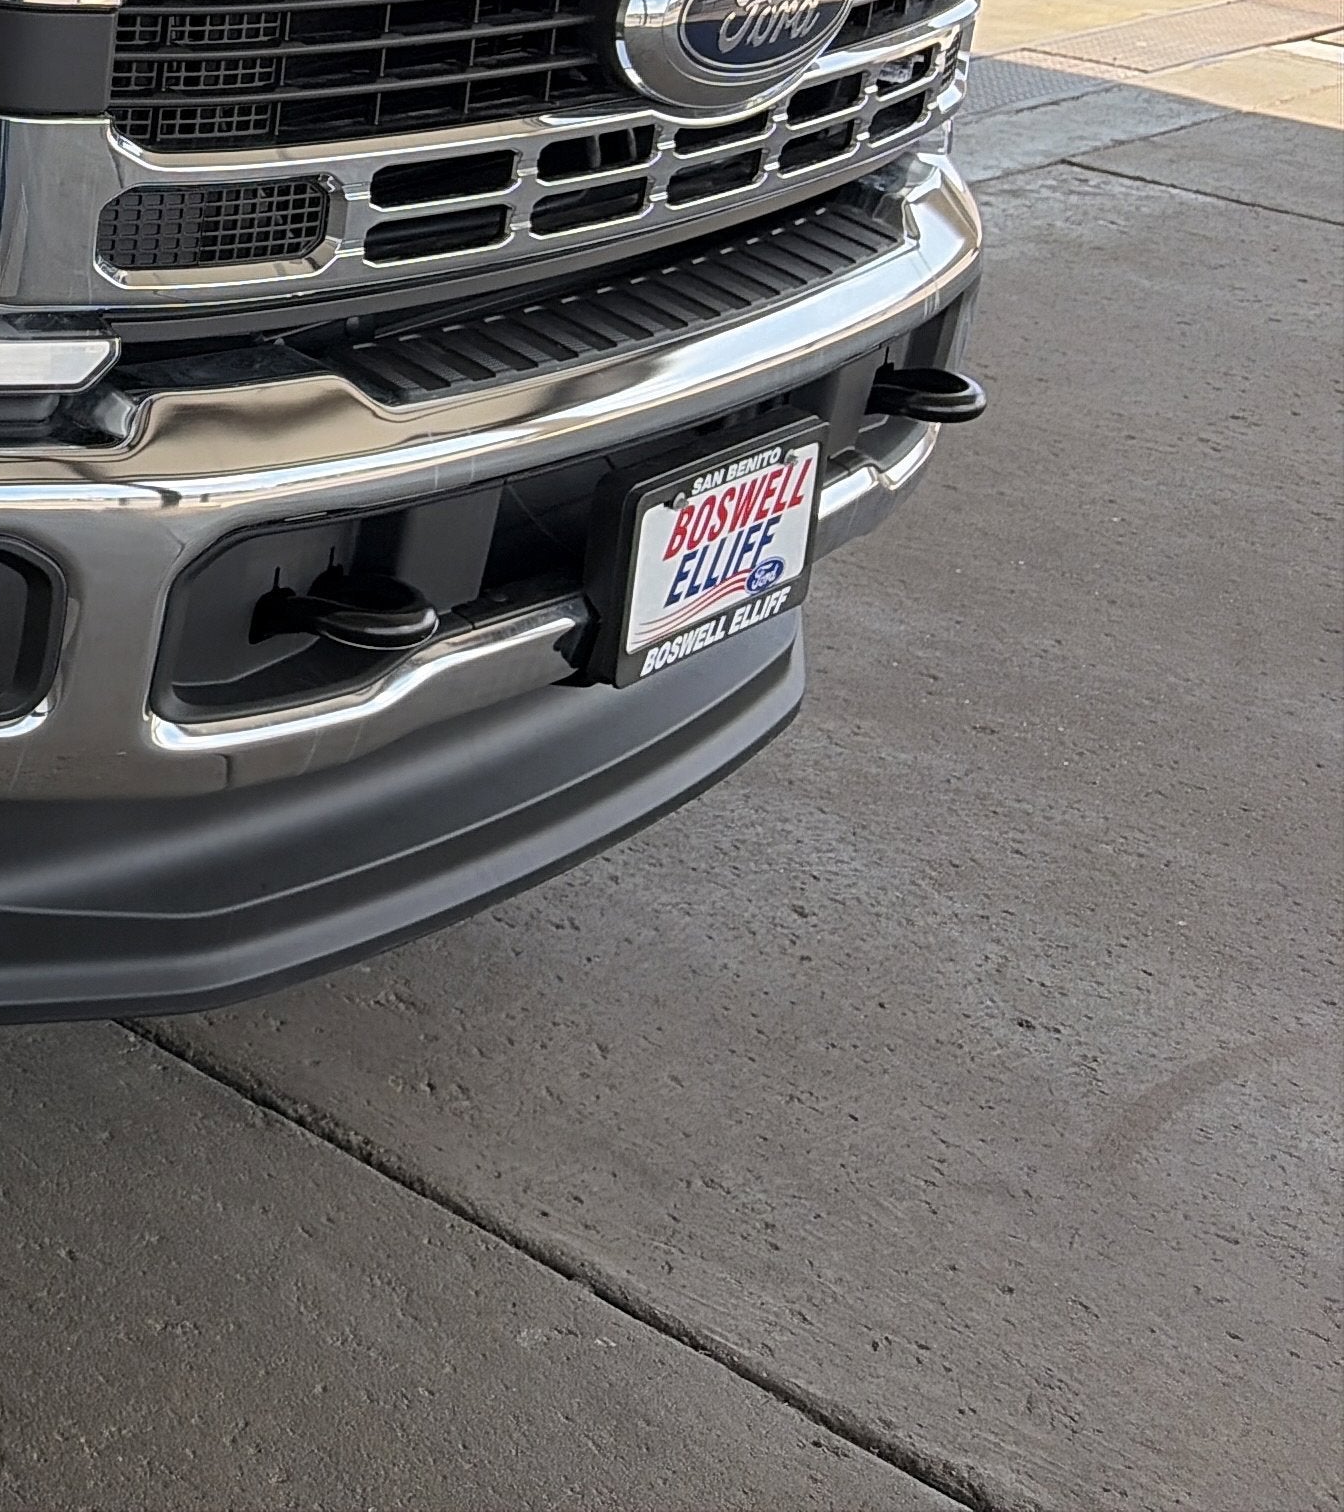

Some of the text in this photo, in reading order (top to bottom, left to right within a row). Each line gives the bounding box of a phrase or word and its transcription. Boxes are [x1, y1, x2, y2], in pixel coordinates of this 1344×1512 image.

[663, 456, 813, 562] BOSWELL
[691, 446, 783, 495] SAN BENITO
[663, 514, 783, 609] ELLIFF
[749, 561, 781, 590] Ford
[639, 586, 792, 678] BOSWELL ELLIFF
